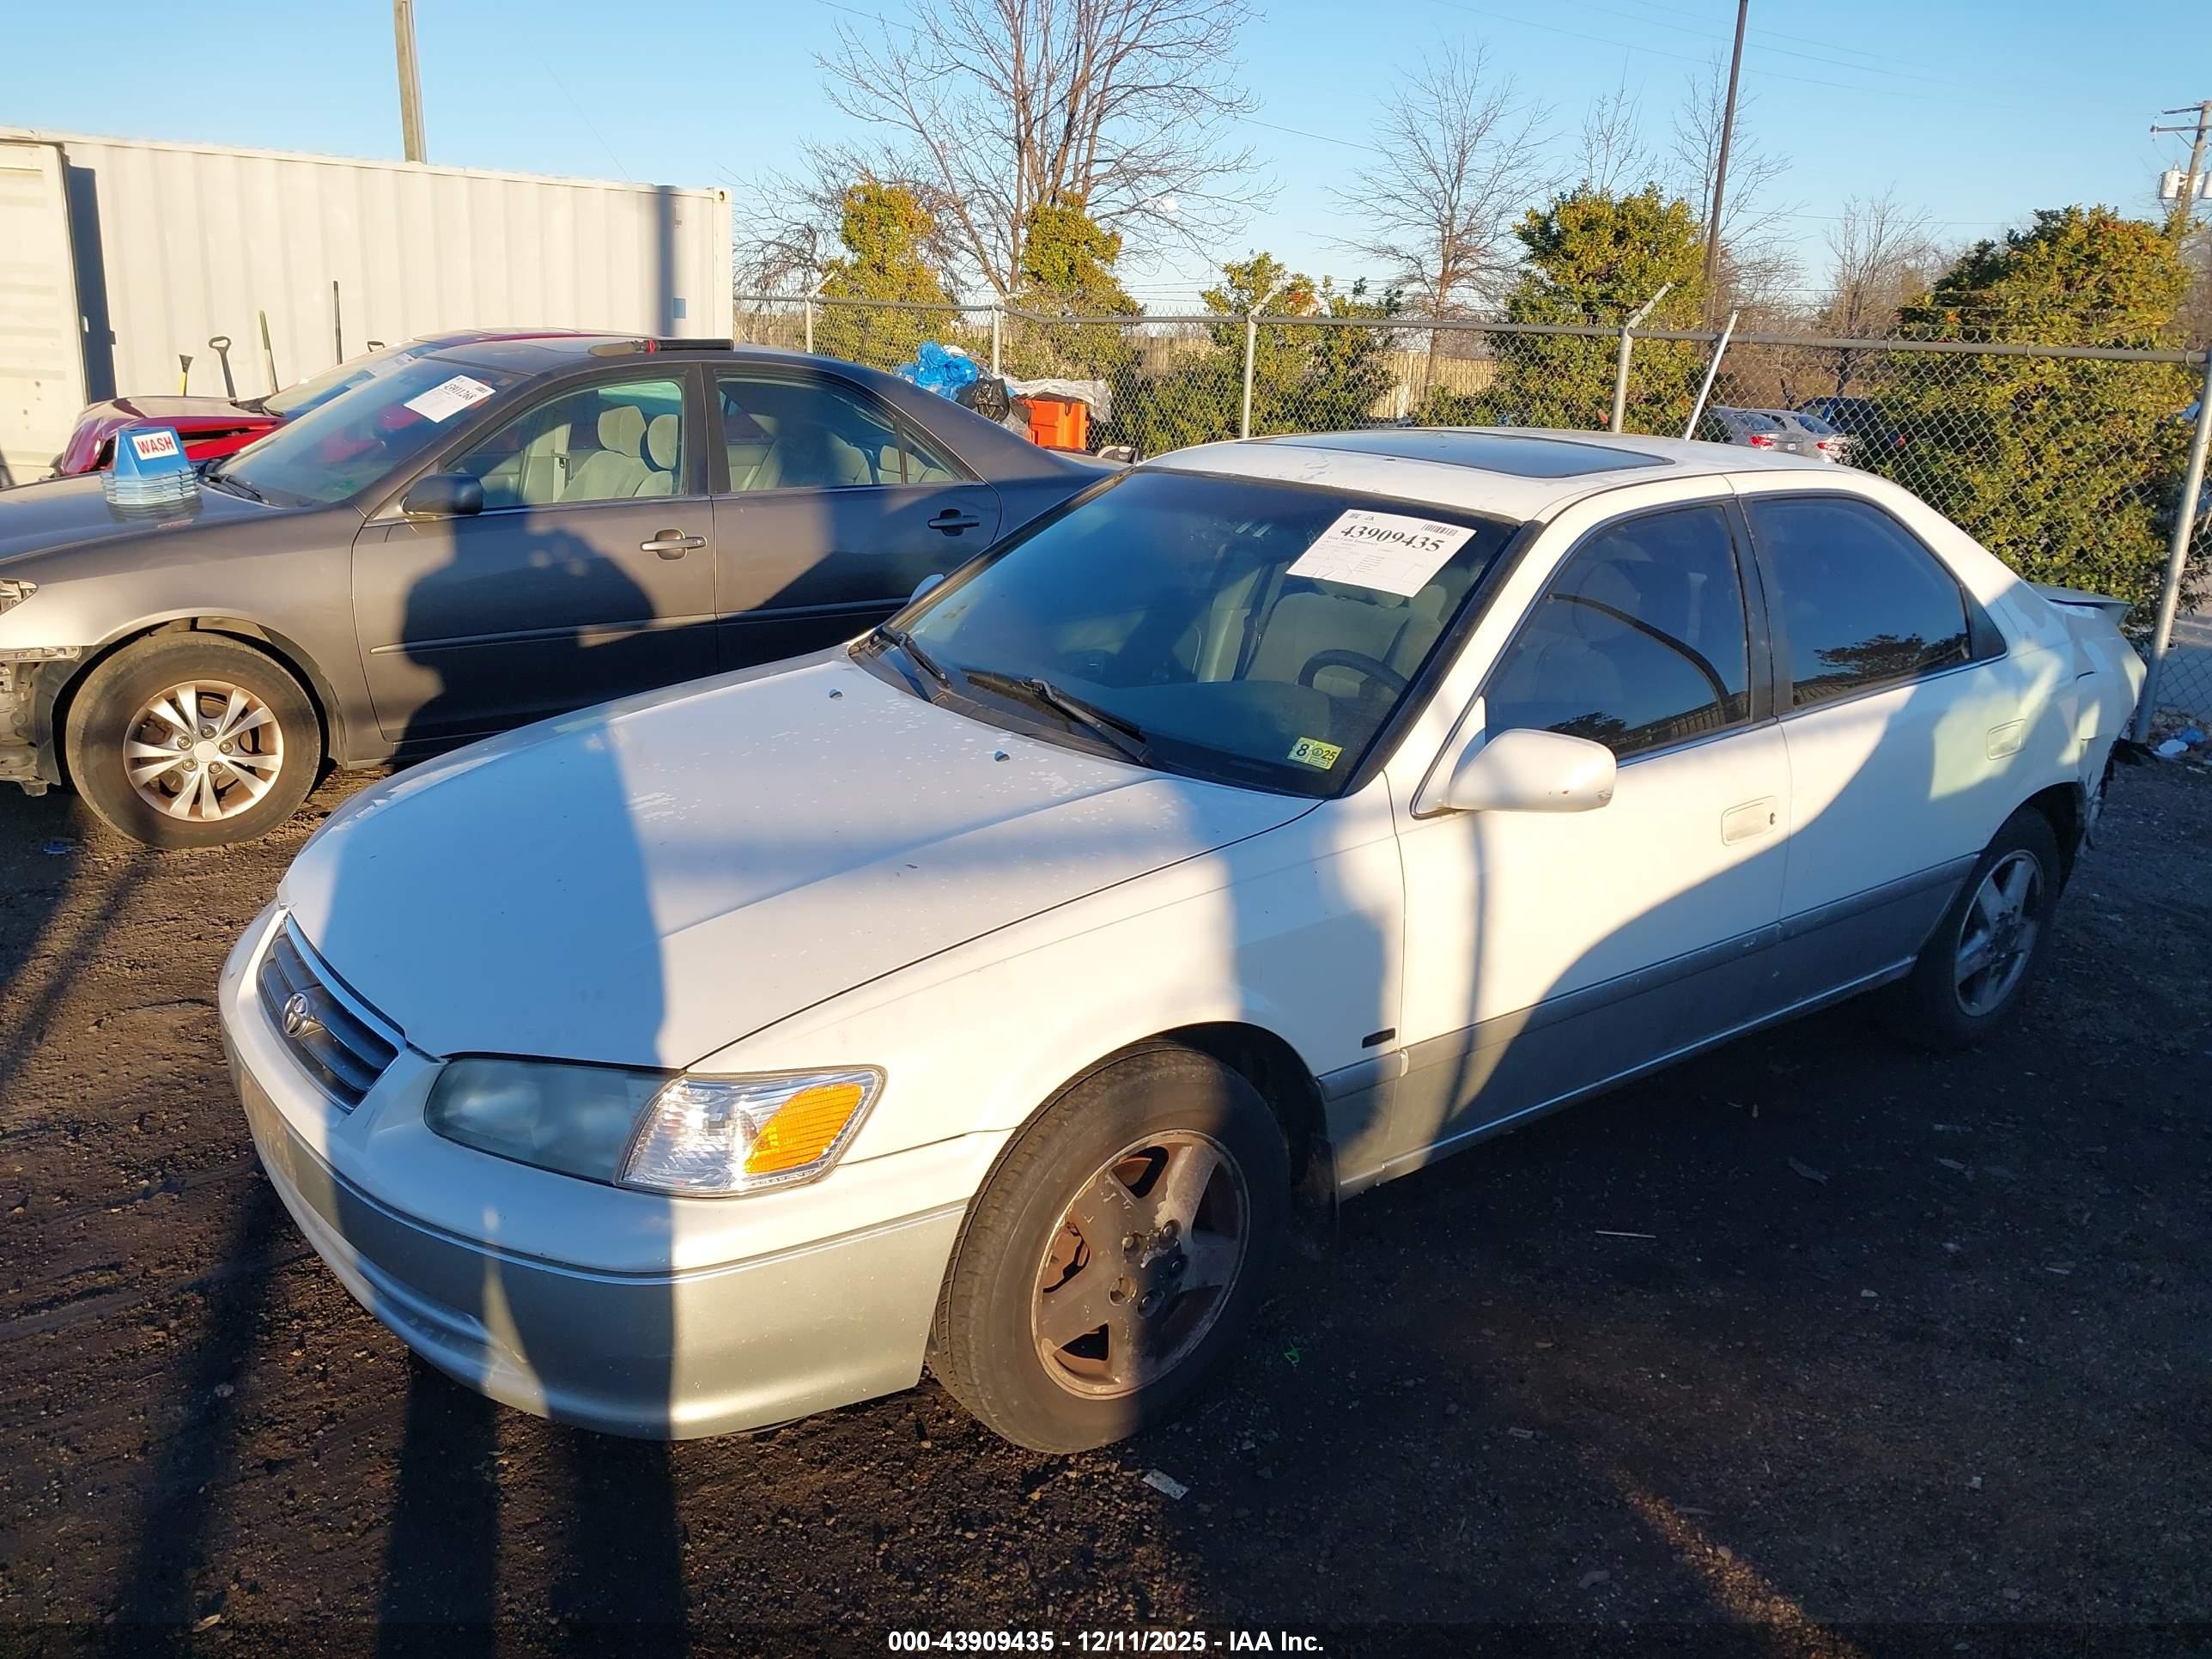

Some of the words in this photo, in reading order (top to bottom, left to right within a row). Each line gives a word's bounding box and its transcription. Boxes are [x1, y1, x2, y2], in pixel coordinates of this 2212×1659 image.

[137, 436, 174, 454] WASH
[1340, 524, 1445, 552] 43909435
[1296, 743, 1310, 757] 8
[1322, 750, 1337, 761] 25
